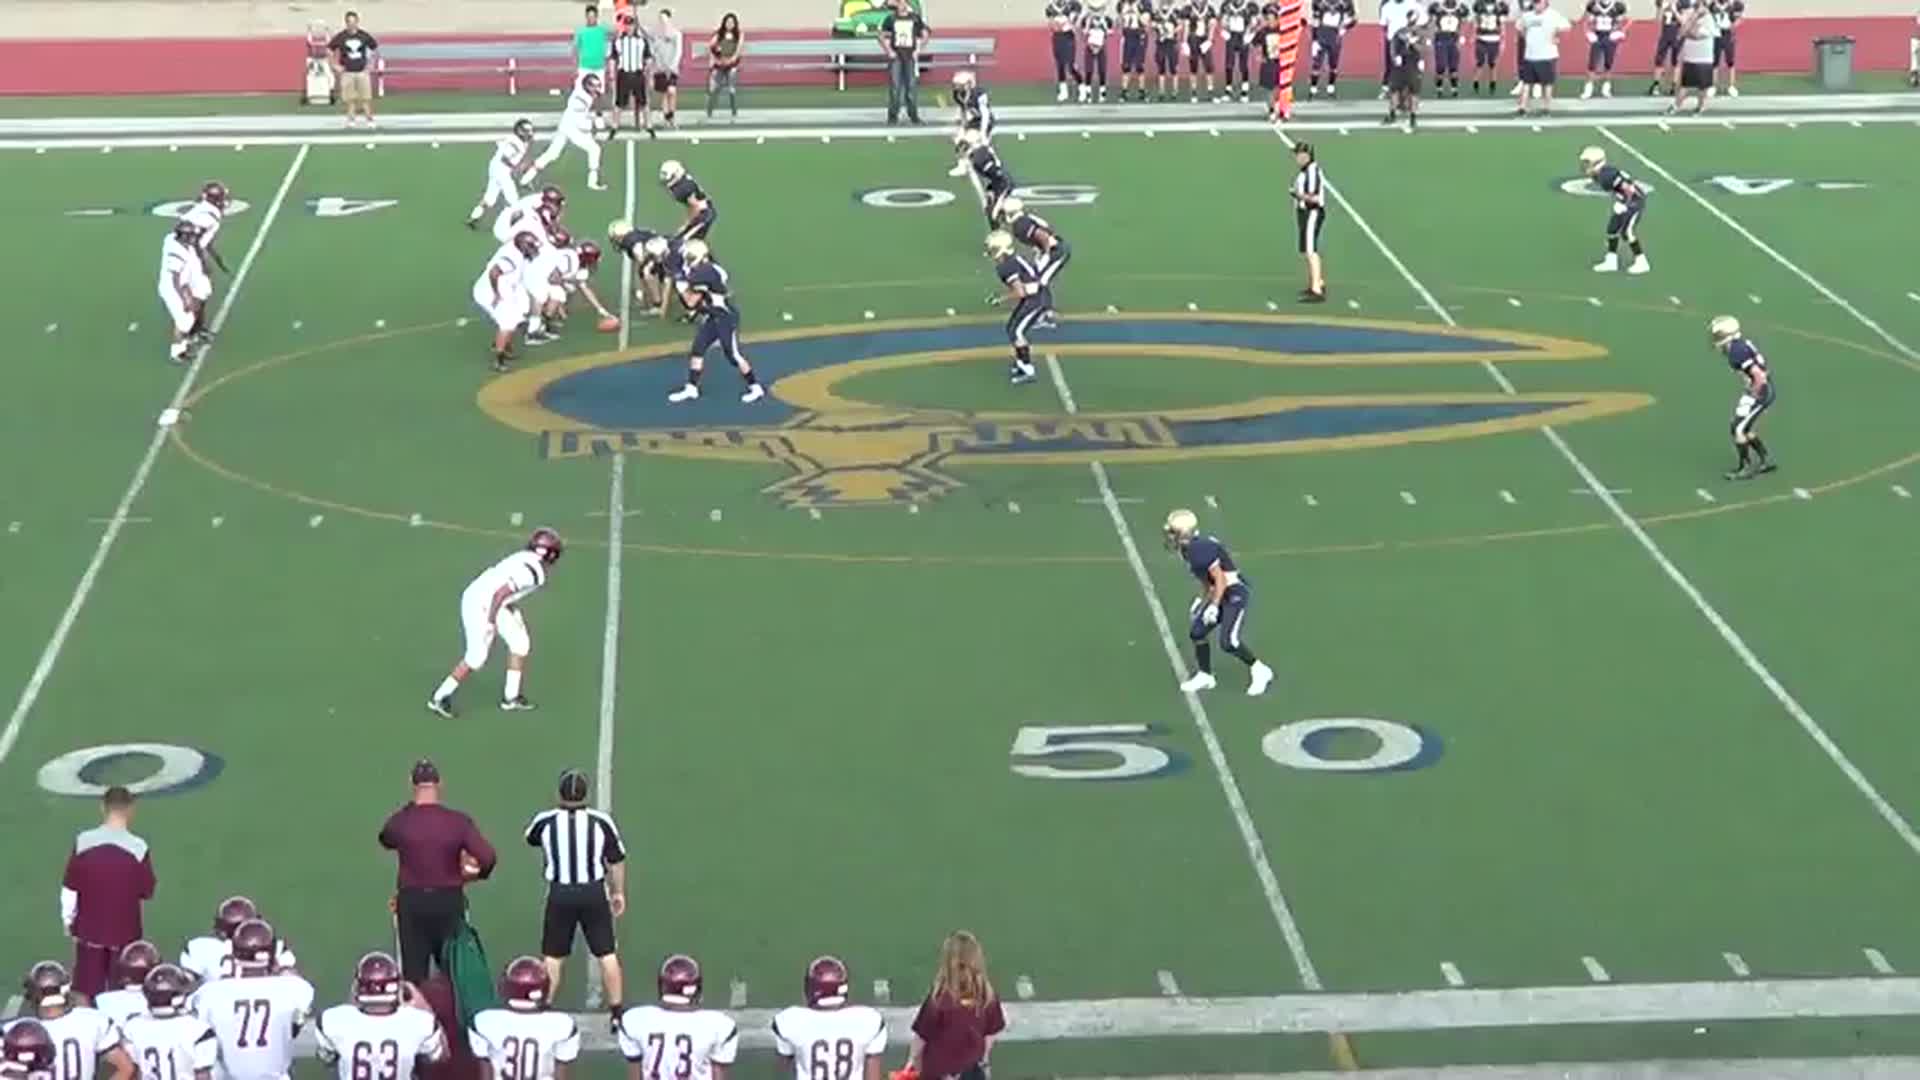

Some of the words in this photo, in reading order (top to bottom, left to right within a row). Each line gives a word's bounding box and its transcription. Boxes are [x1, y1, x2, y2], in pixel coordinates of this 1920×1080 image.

[234, 998, 271, 1048] 77
[144, 1046, 176, 1080] 31
[354, 1039, 398, 1080] 63
[502, 1035, 539, 1080] 30
[649, 1033, 692, 1080] 73
[811, 1038, 853, 1080] 68
